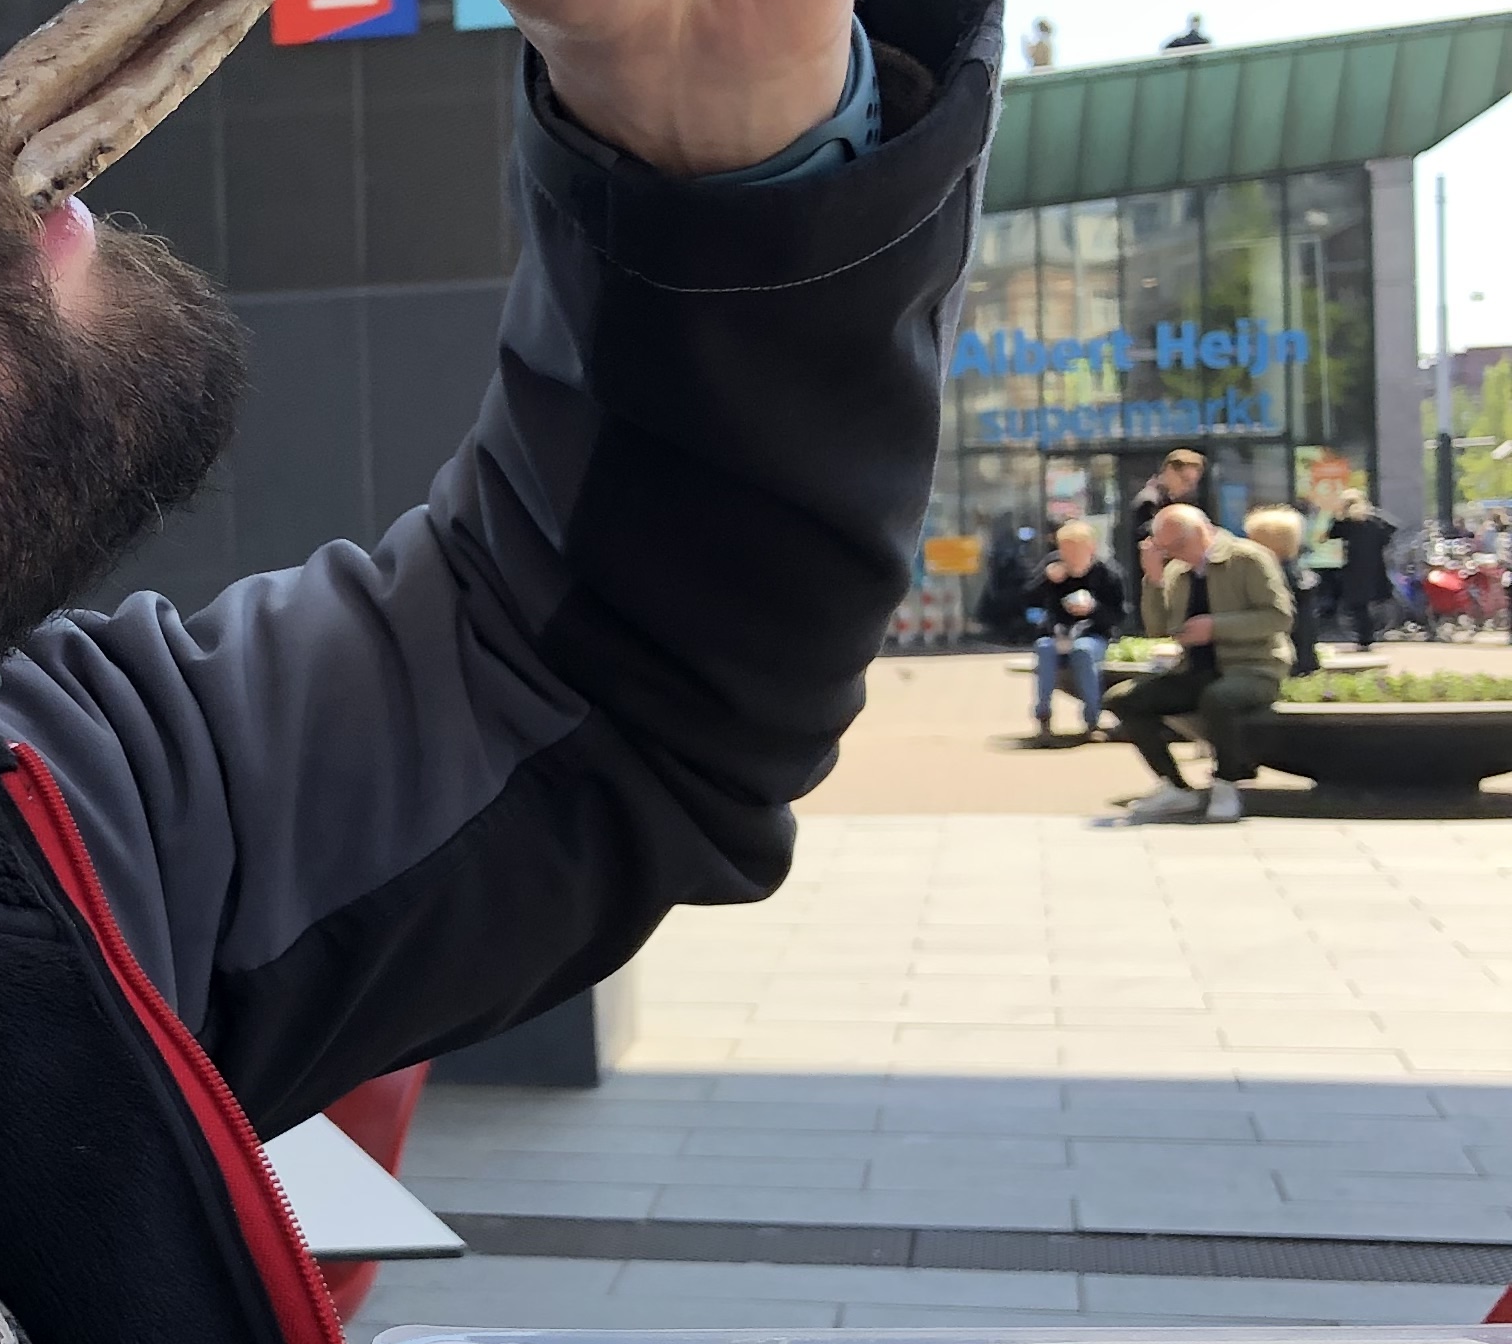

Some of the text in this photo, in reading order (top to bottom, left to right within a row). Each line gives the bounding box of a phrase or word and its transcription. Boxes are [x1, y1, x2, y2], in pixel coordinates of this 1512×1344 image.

[950, 316, 1309, 378] Albert Heijn
[978, 386, 1281, 448] supermarkt
